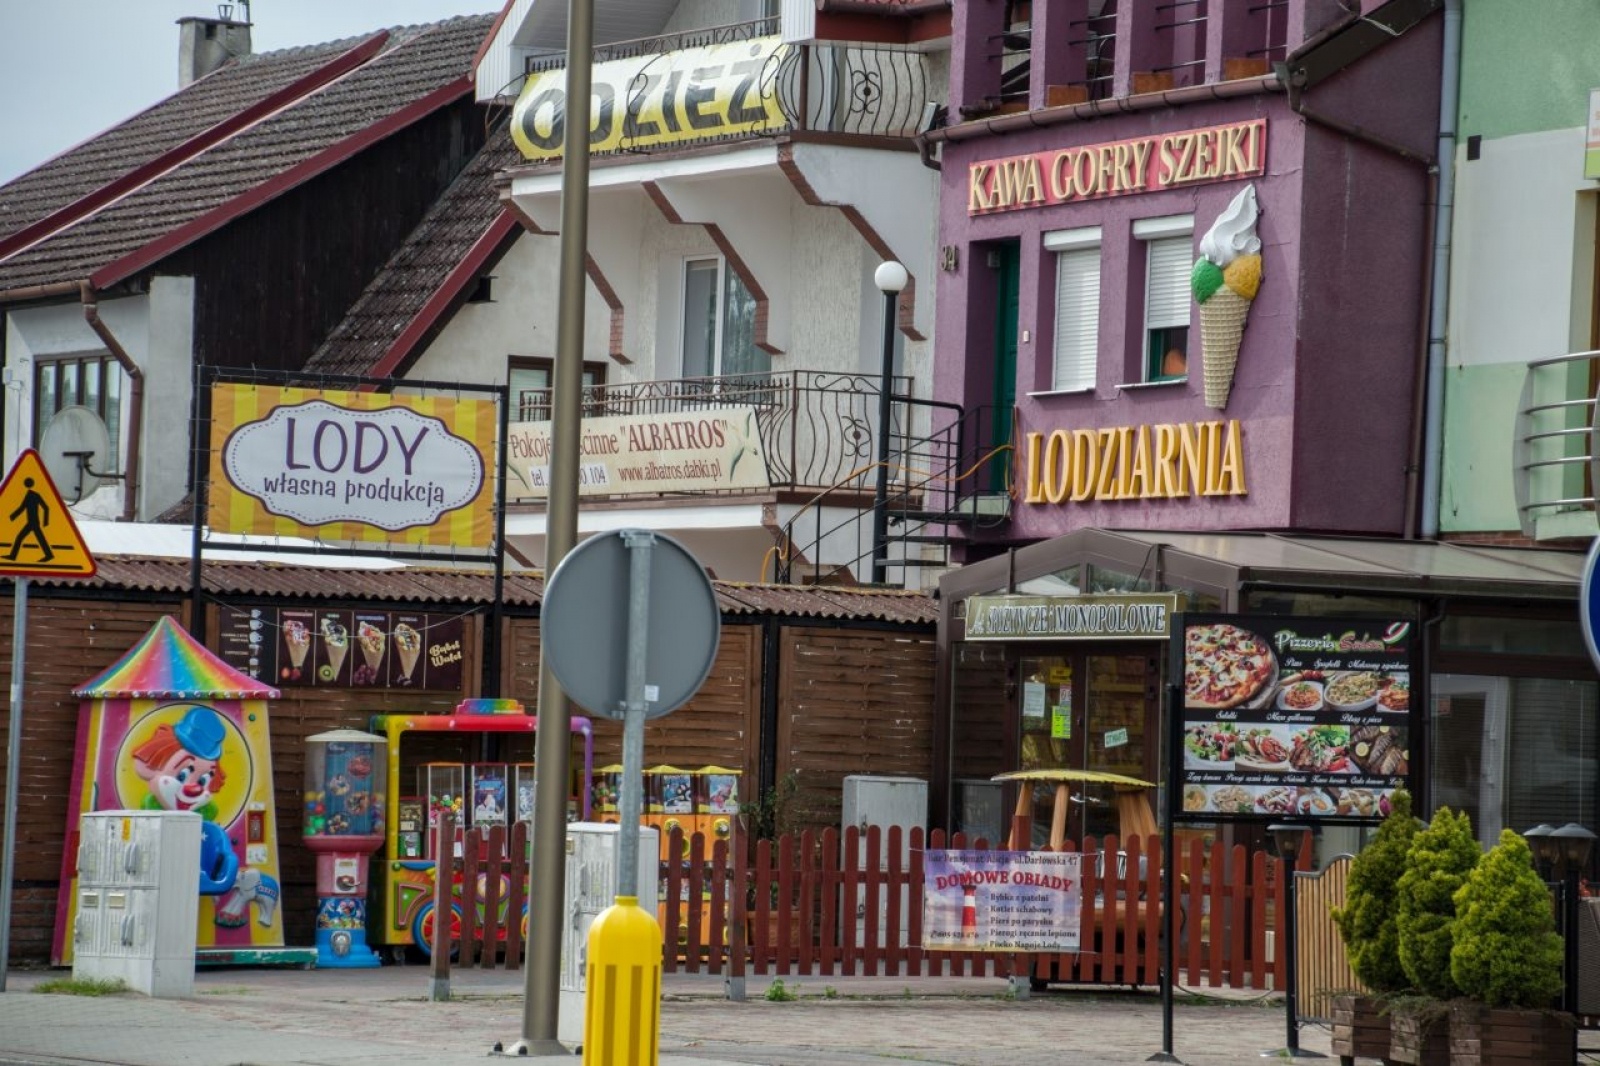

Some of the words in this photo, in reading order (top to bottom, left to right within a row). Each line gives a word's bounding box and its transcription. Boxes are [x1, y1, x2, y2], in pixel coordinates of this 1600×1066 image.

[969, 158, 1045, 211] KAWA
[1051, 140, 1153, 199] GOFRY
[1158, 123, 1261, 185] SZEJKI
[286, 417, 430, 475] LODY
[620, 419, 728, 452] "ALBATROS"
[1024, 420, 1249, 503] LODZIARNIA
[264, 473, 336, 497] własna
[345, 477, 444, 506] produkcja
[1055, 604, 1165, 634] MONOPOLOWE
[1275, 630, 1335, 650] Pizzeria
[936, 870, 1009, 890] DOMOWE
[1012, 871, 1074, 892] OBIADY
